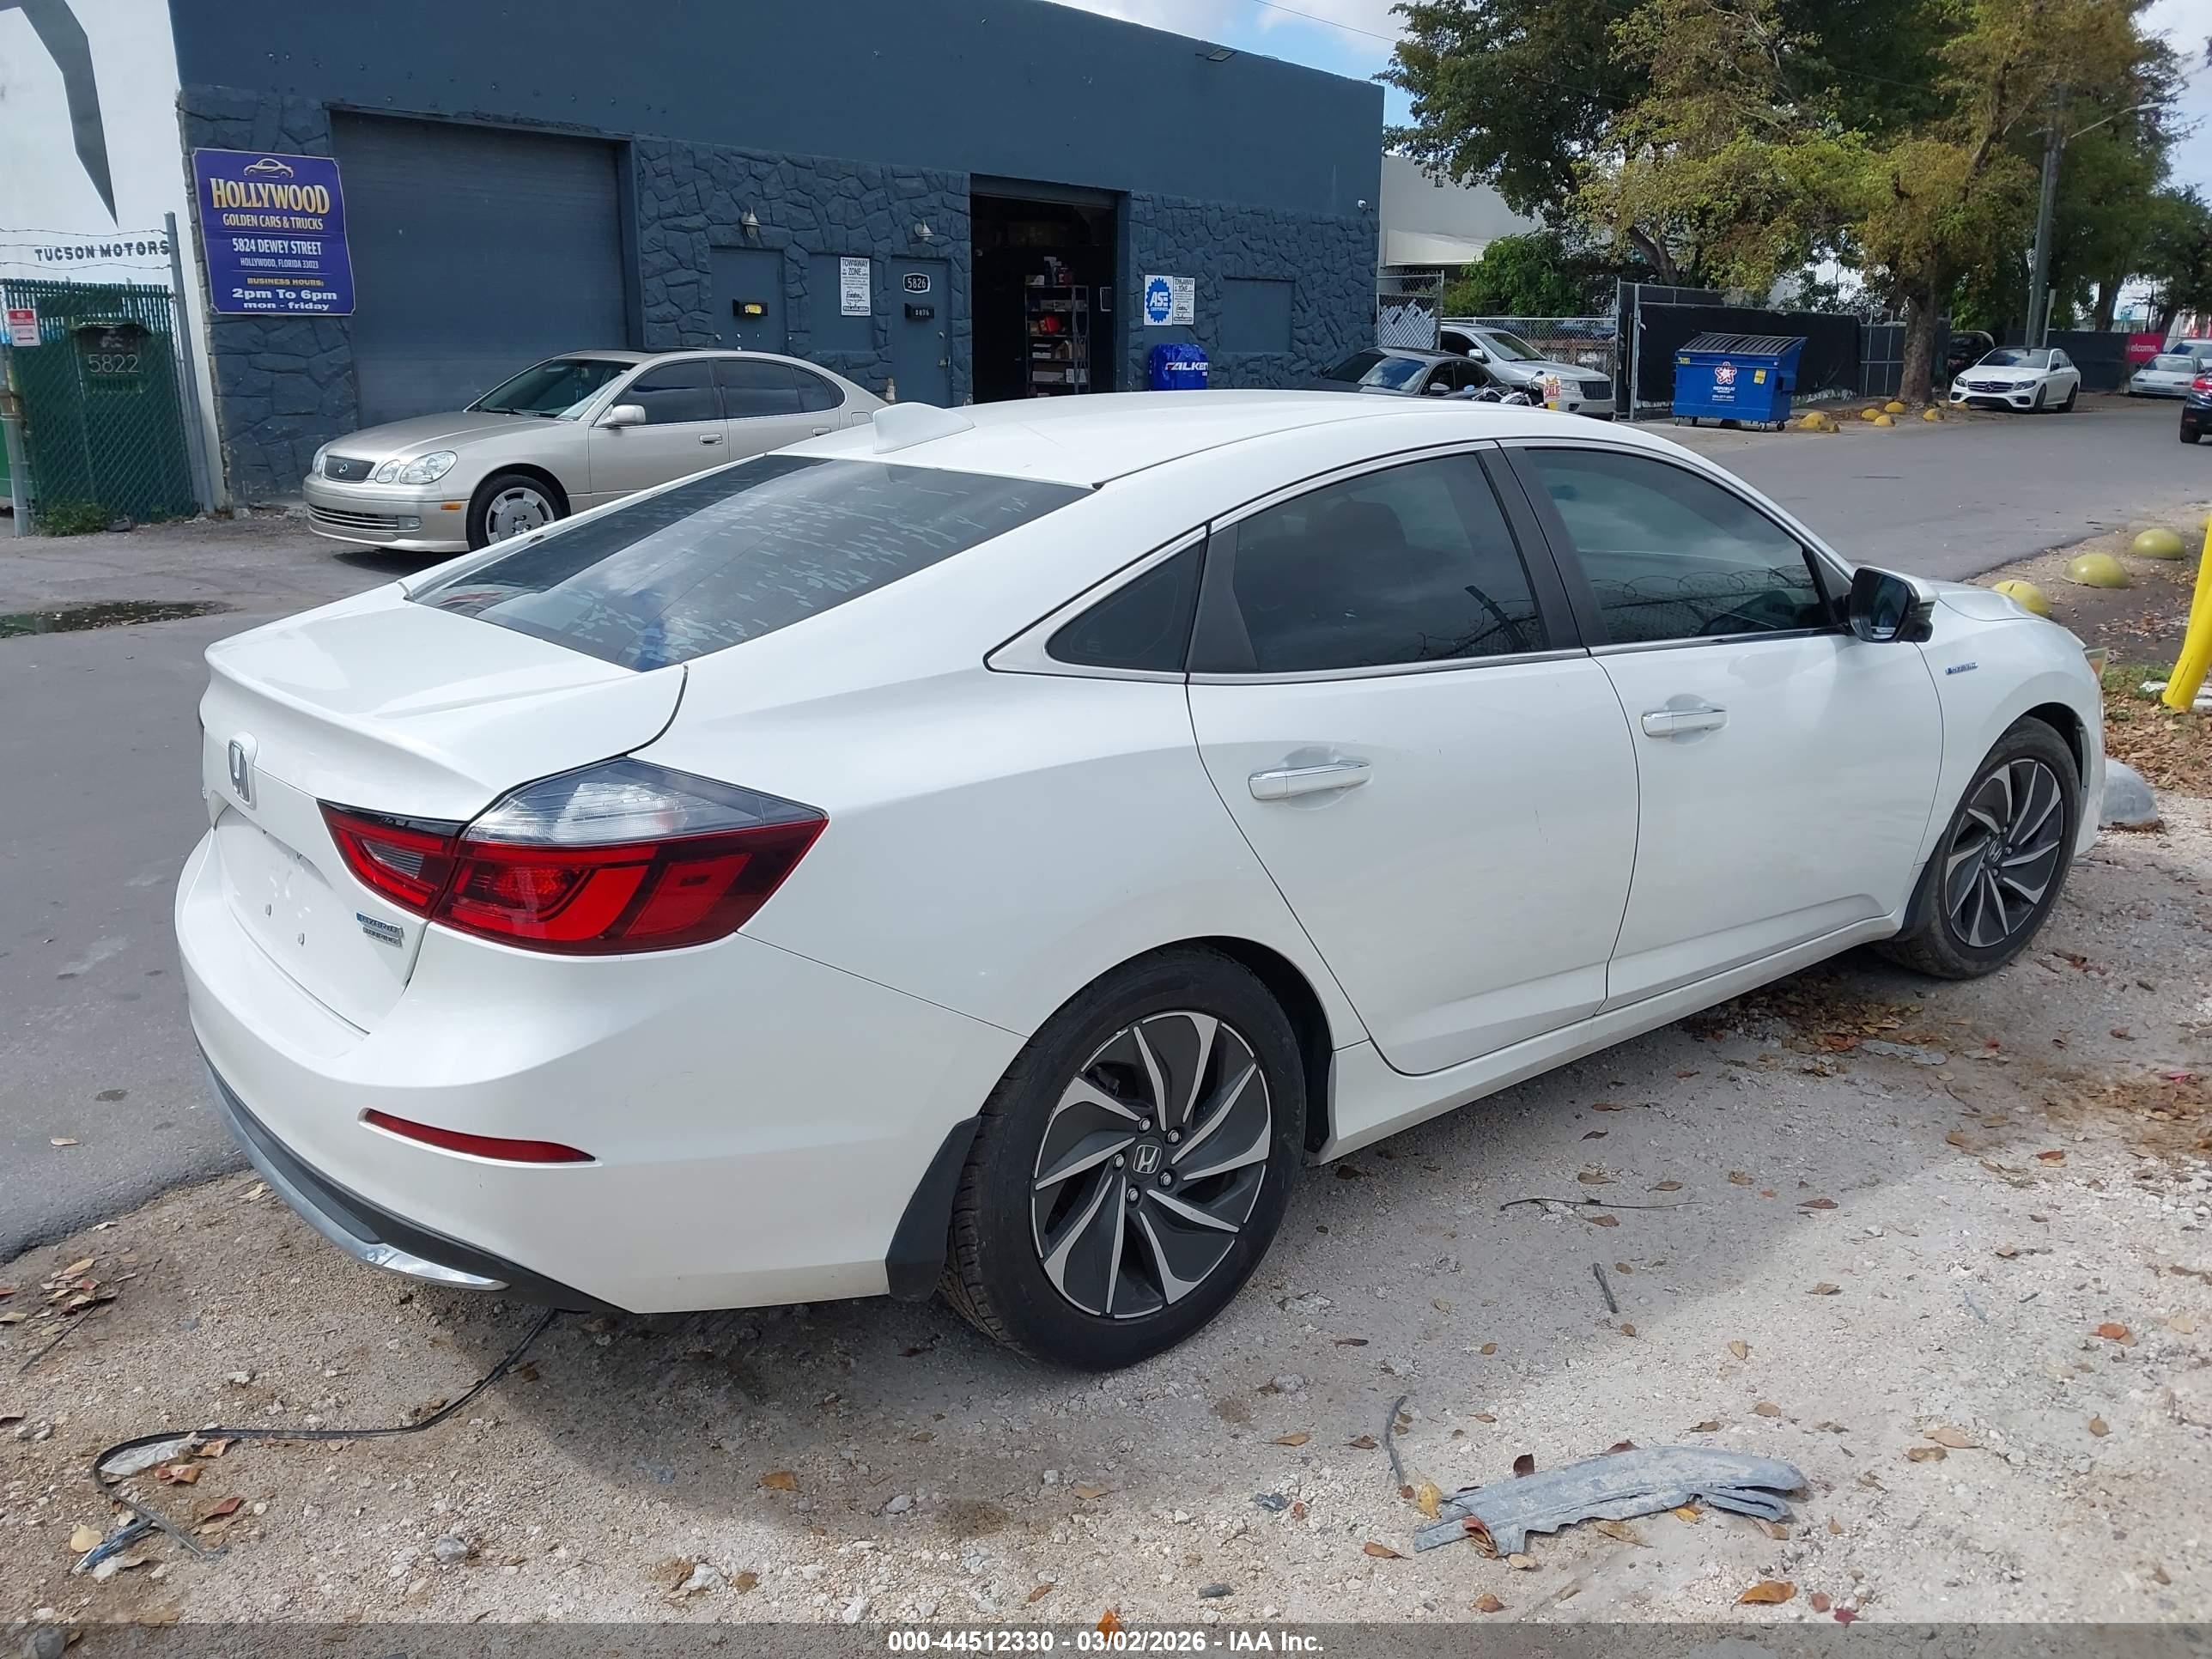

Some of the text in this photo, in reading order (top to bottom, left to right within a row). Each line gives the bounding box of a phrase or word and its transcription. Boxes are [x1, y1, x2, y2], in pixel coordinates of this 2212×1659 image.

[210, 177, 331, 215] HOLLYWOOD
[222, 214, 324, 230] GOLDEN CARS & TRUCKS
[34, 240, 170, 261] TUCSON MOTORS
[232, 237, 322, 256] 5824 DEWEY STREET
[240, 257, 277, 269] HOLLYWOOD,
[278, 258, 301, 269] FLORIDA
[246, 276, 290, 286] BUSINESS
[907, 277, 927, 289] 5826
[231, 287, 337, 301] 2pm To 6pm
[1149, 291, 1169, 307] ASE
[288, 301, 330, 312] friday
[88, 354, 139, 373] 5822
